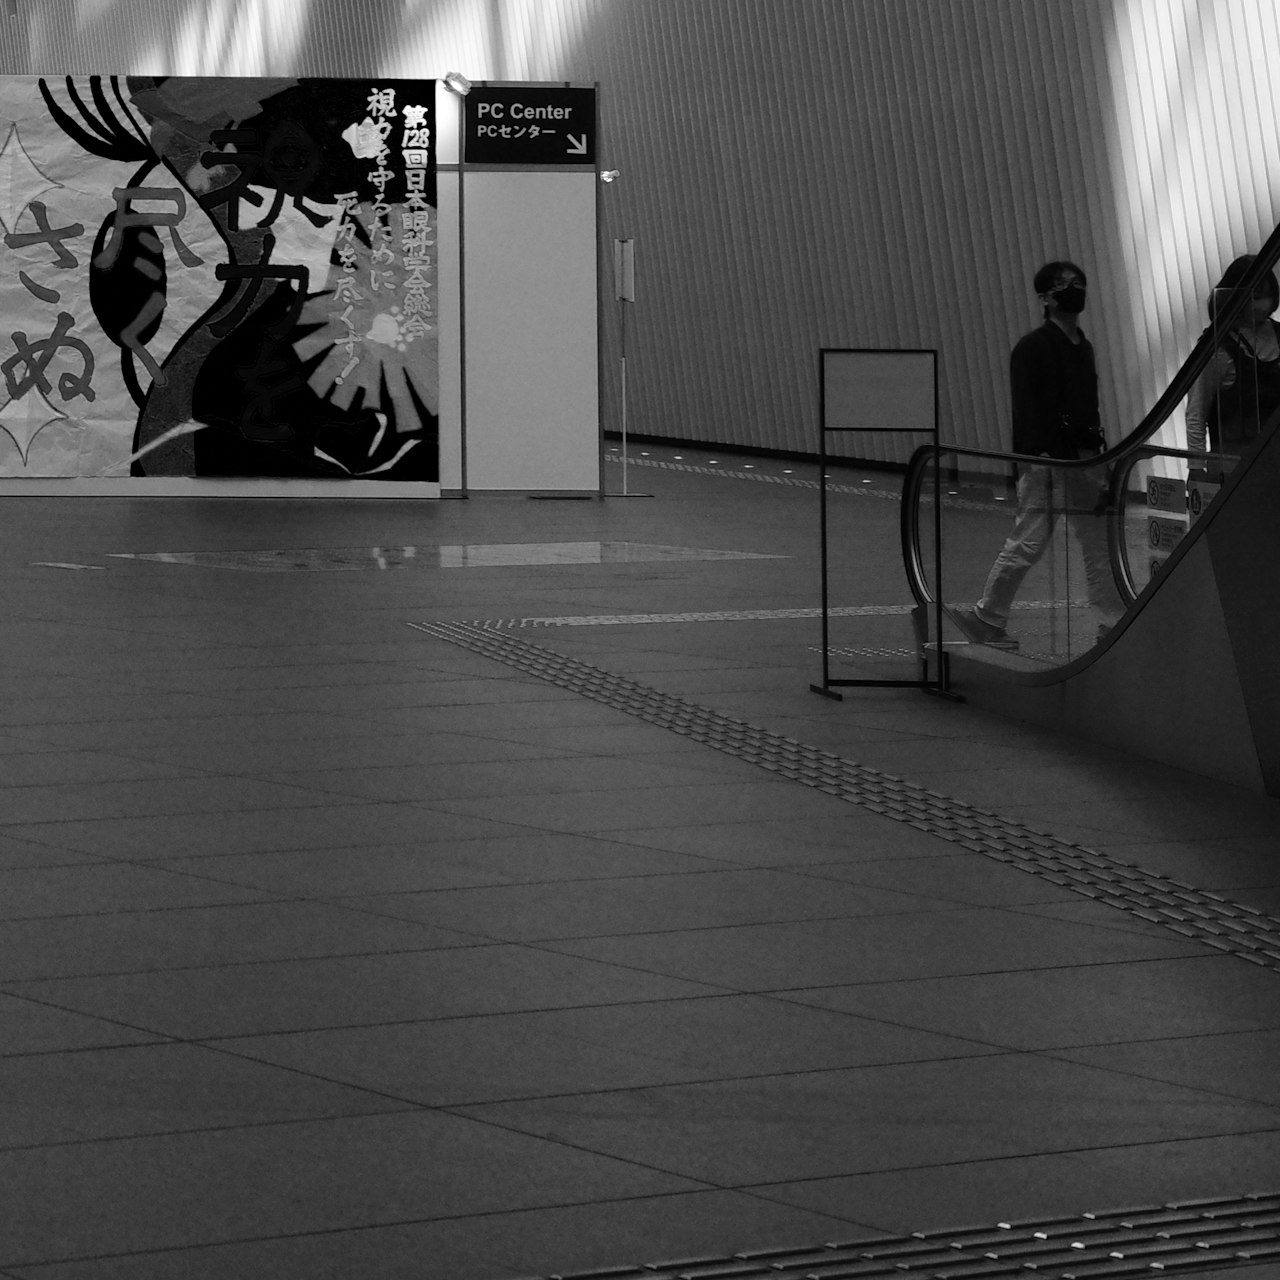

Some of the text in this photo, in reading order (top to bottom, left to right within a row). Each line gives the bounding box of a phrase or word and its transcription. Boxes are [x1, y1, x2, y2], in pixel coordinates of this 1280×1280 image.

[477, 103, 572, 120] PC Center
[477, 124, 557, 139] PCセンター
[401, 104, 432, 339] 第128回日本眼科学会総会
[0, 201, 97, 402] さぬ
